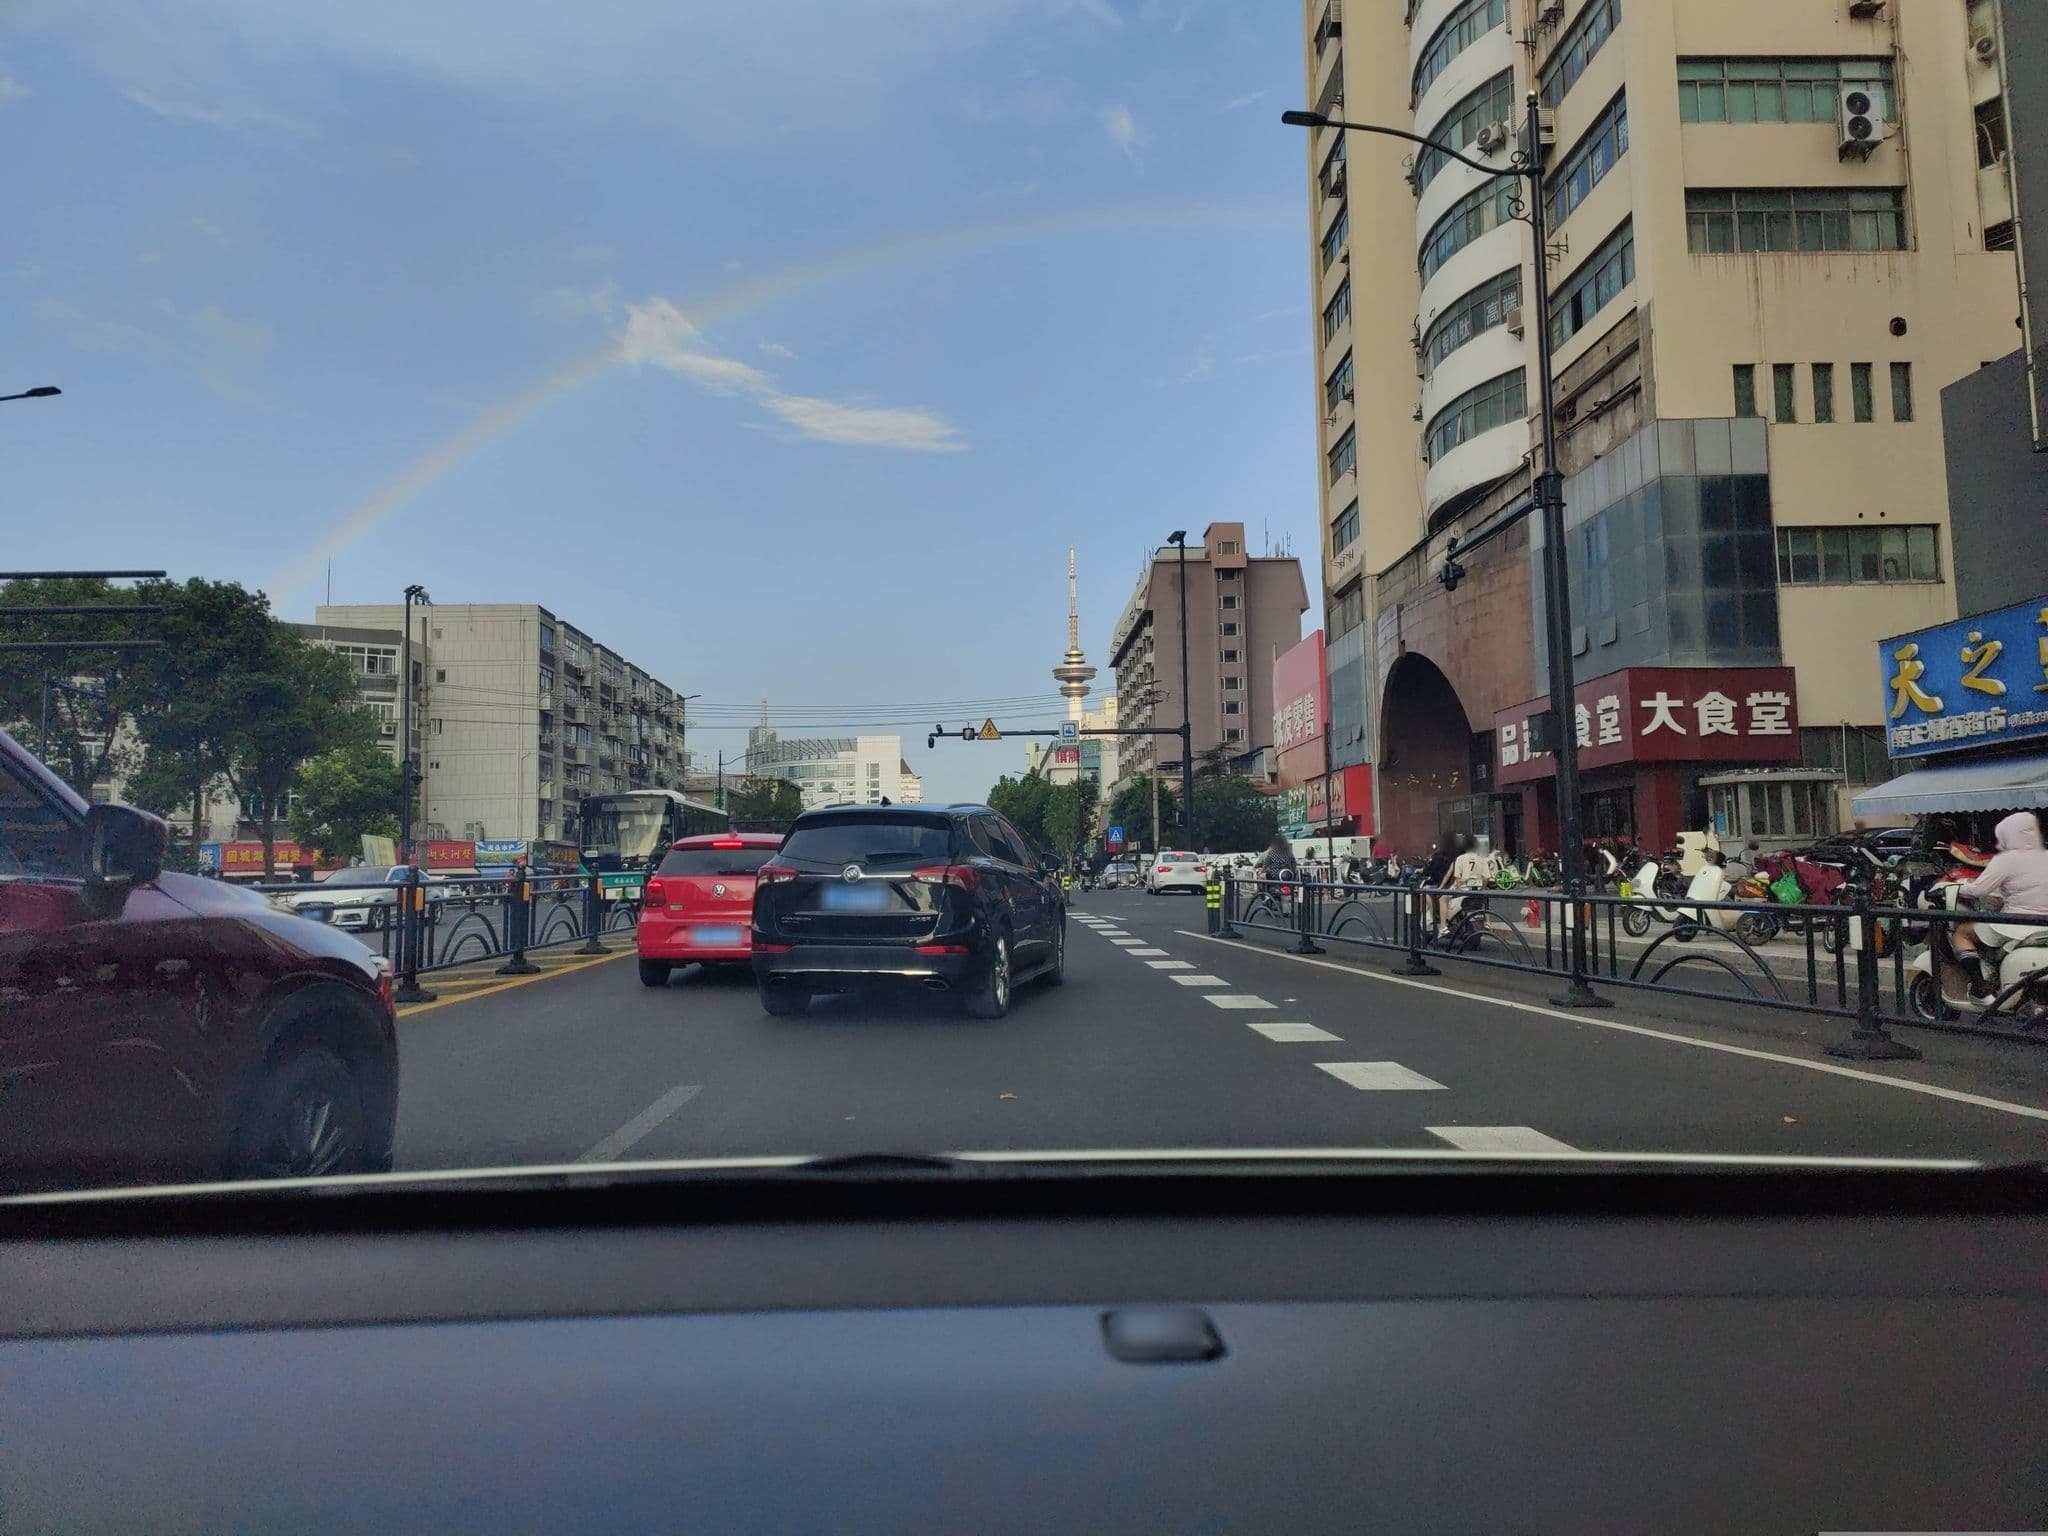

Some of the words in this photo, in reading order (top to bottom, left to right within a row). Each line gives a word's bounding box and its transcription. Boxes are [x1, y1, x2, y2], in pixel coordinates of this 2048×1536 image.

[1501, 695, 1623, 767] 品食堂
[1640, 691, 1793, 736] 大食堂
[1469, 861, 1476, 872] 7
